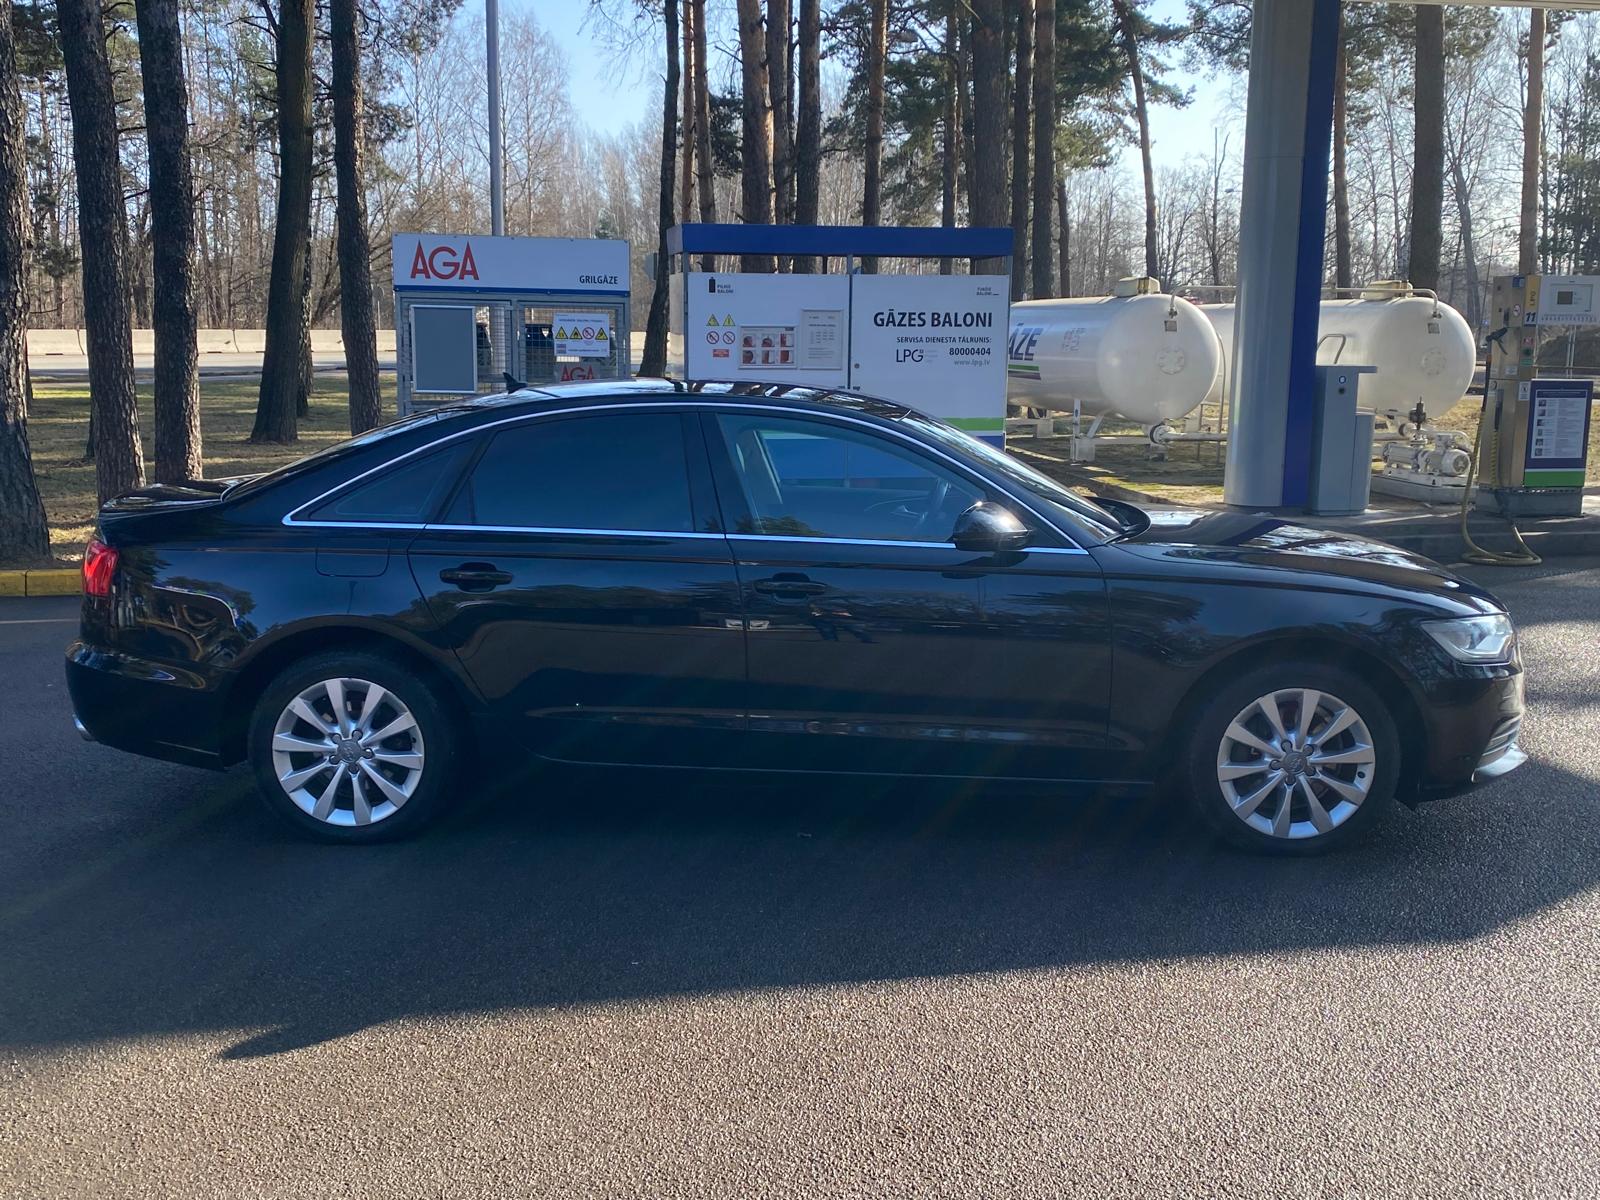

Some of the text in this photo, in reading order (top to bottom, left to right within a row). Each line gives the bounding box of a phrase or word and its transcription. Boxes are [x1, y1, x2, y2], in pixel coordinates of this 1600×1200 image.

[410, 239, 480, 281] AGA
[873, 308, 993, 328] GĀZES BALONI
[896, 336, 924, 344] SERVISA
[925, 336, 957, 344] DIENESTA
[895, 348, 924, 363] LPG
[948, 347, 991, 356] 80000404
[560, 364, 595, 382] AGA
